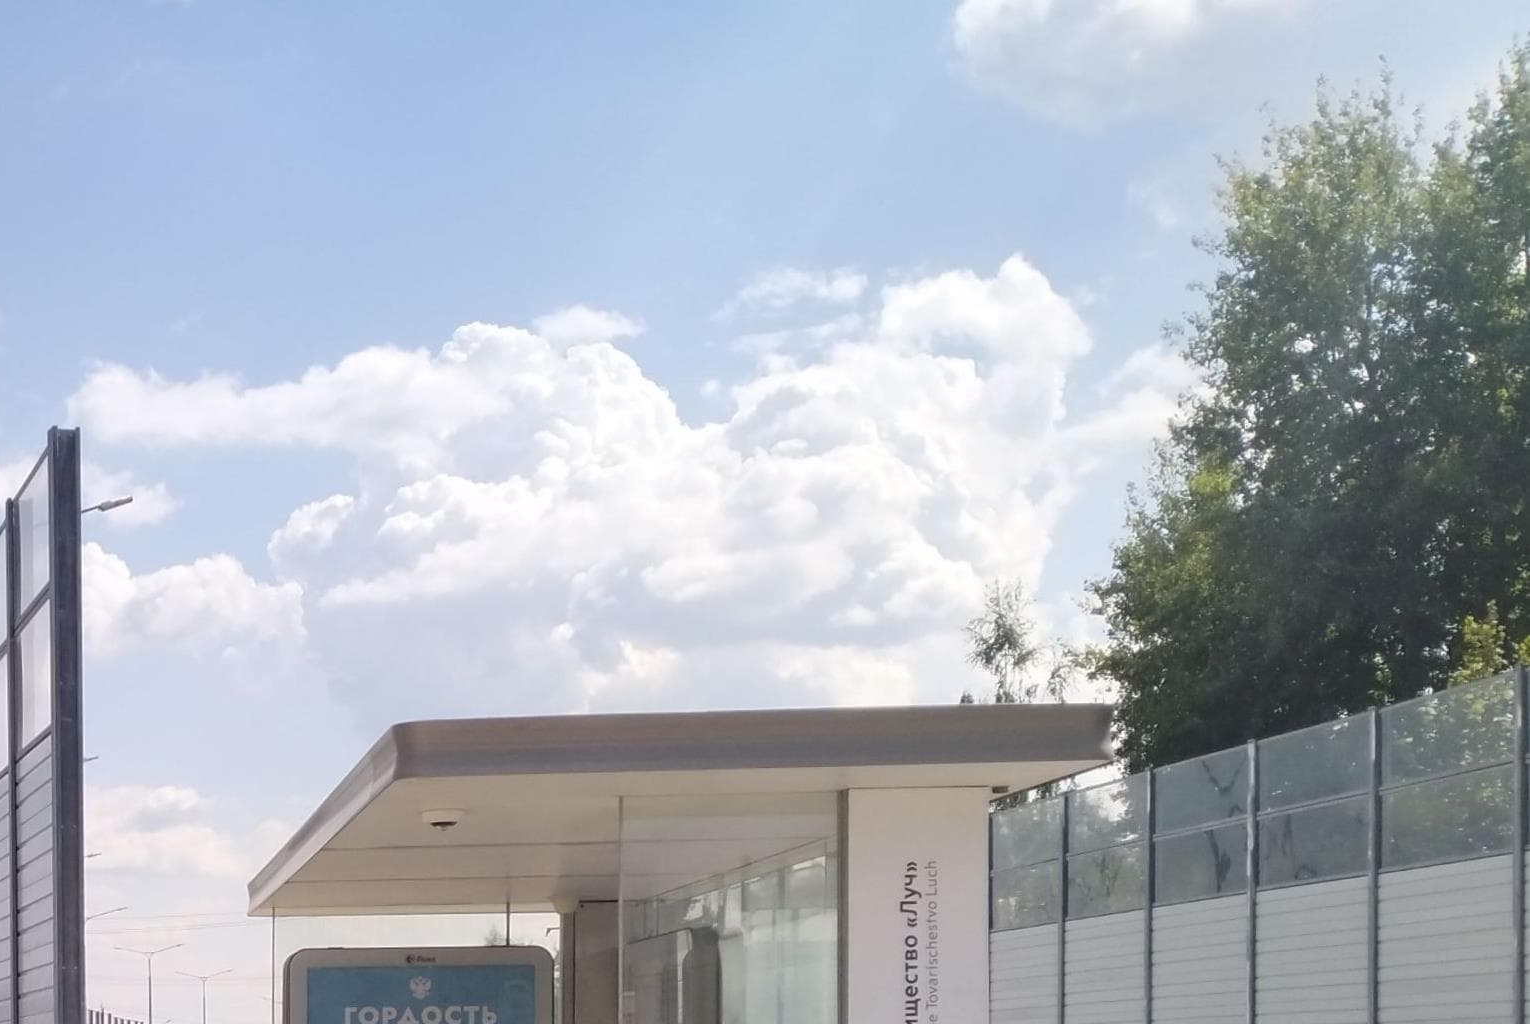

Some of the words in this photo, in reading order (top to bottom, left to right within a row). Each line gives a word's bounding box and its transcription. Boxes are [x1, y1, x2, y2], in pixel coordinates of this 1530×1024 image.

[900, 861, 922, 928] «Луч»
[924, 860, 938, 896] Luch
[925, 900, 939, 1010] Tovarischestvo
